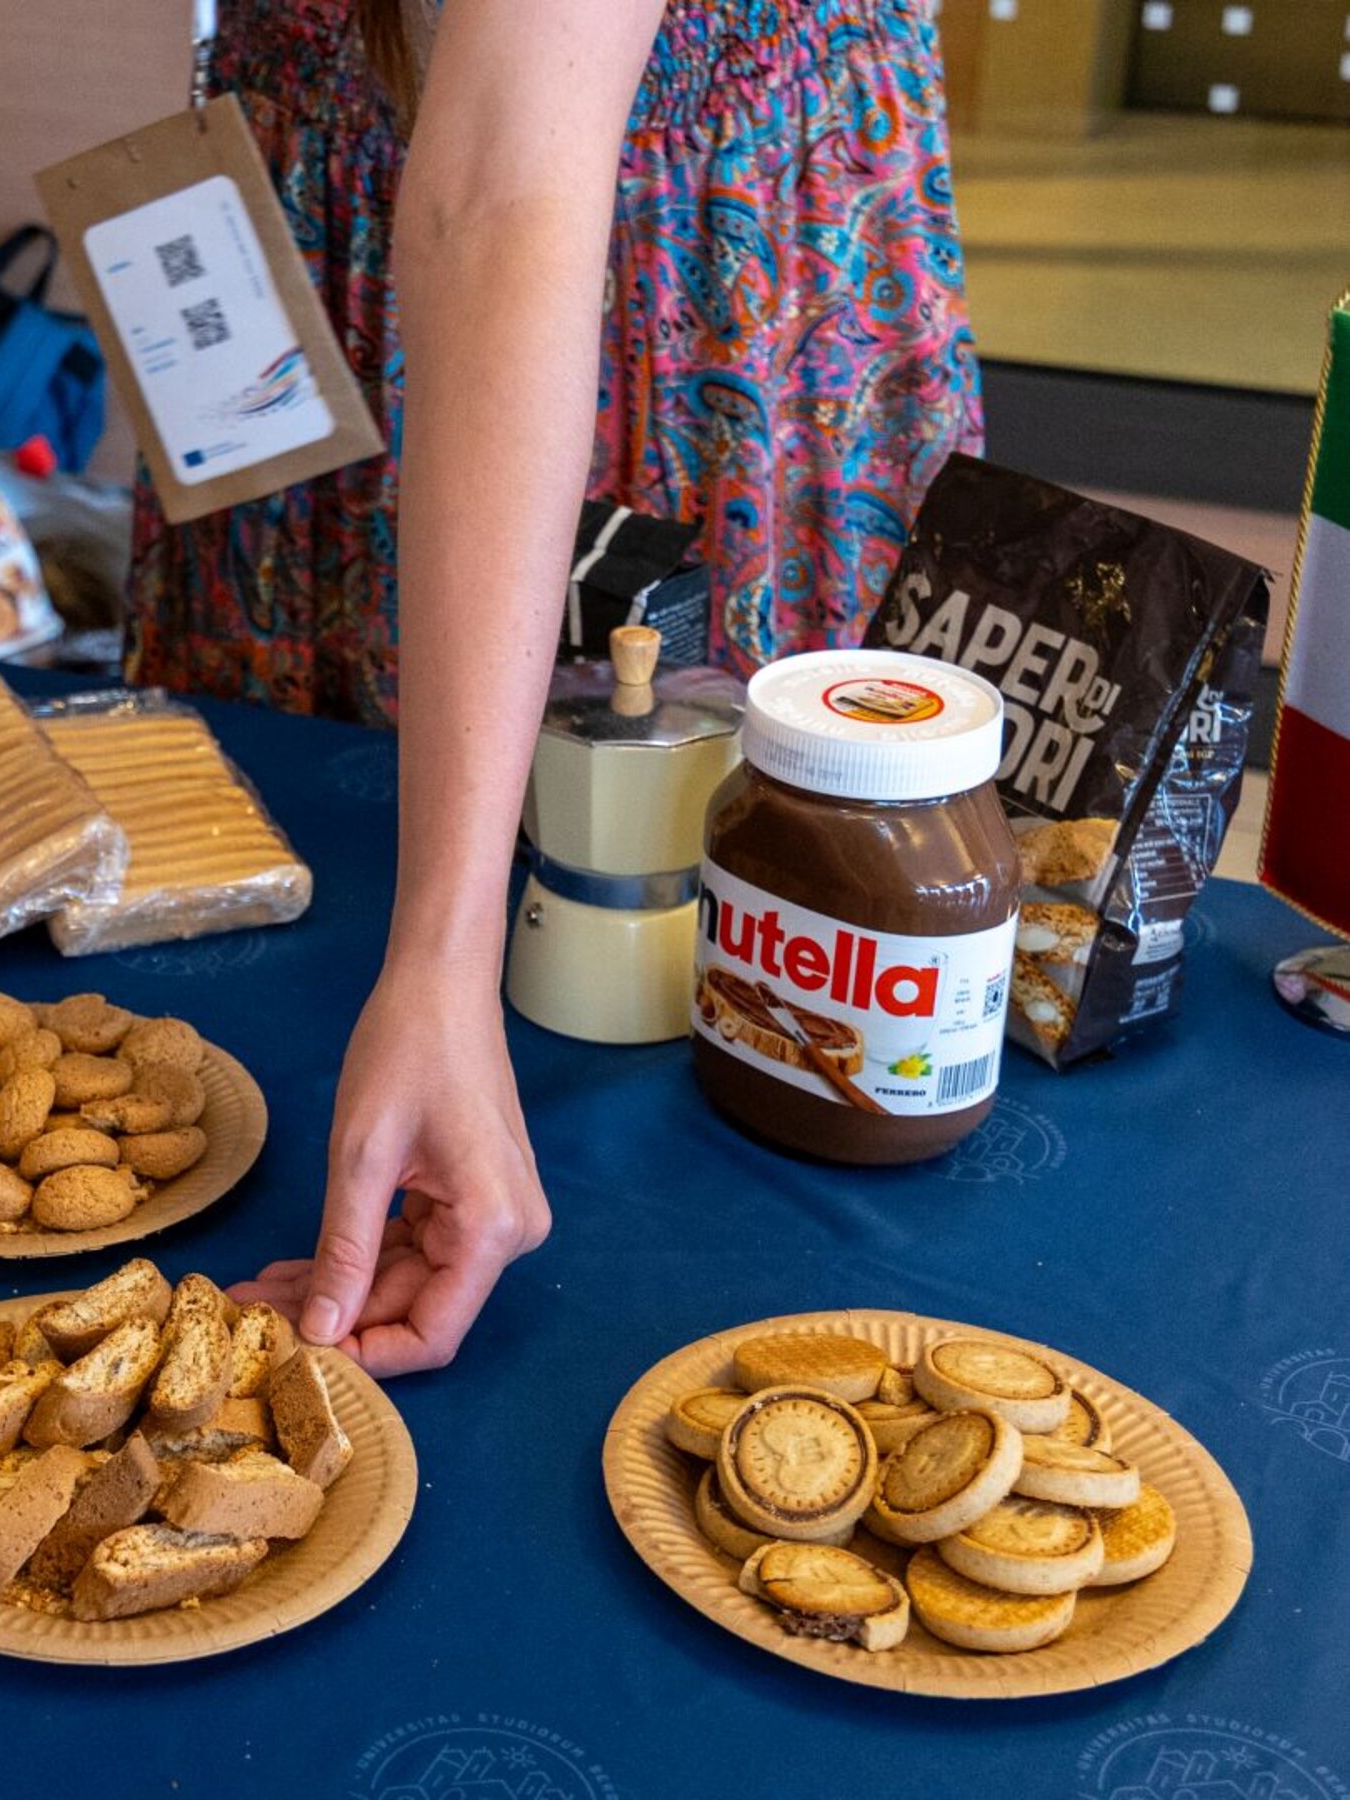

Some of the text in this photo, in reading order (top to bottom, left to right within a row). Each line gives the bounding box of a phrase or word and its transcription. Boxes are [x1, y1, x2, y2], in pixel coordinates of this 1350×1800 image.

[884, 567, 1105, 735] SAPER
[700, 882, 940, 1019] nutella
[875, 1086, 927, 1097] FERRERO
